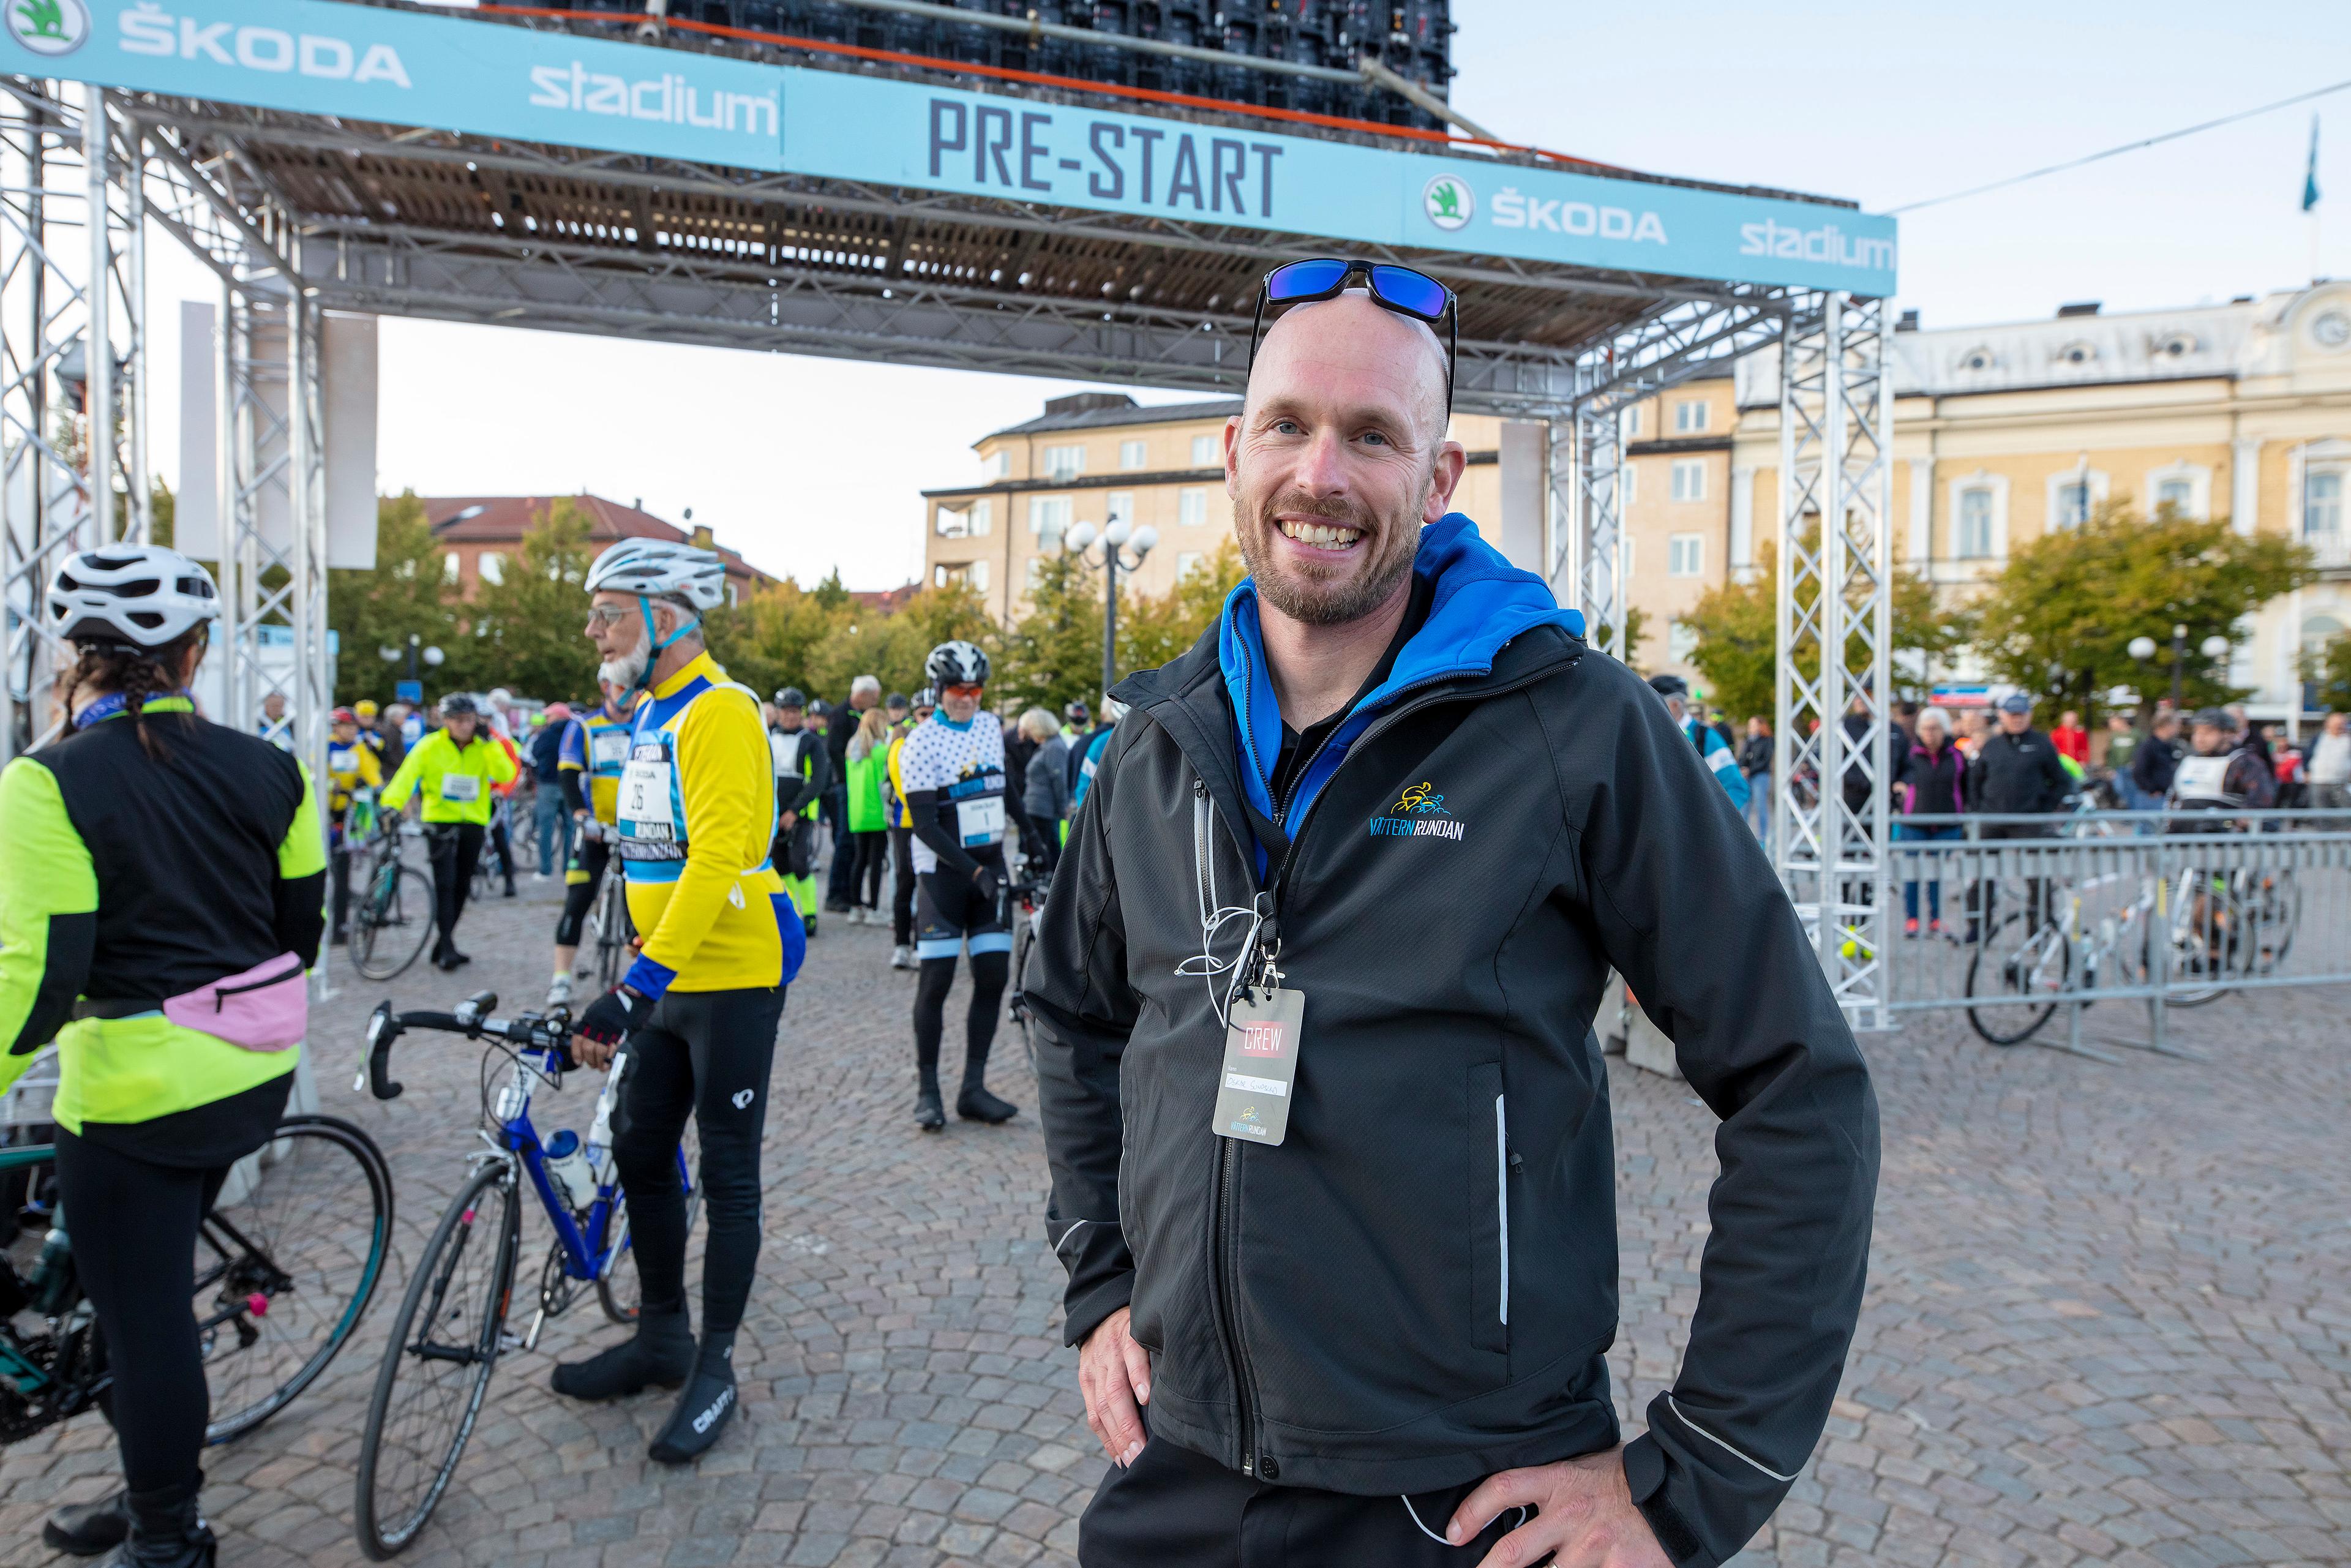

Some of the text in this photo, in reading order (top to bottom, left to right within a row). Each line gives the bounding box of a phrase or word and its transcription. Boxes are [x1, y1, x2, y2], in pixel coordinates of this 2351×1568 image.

[118, 2, 412, 89] ŠKODA
[529, 61, 778, 137] stadium
[929, 98, 1283, 217] PRE-START
[1491, 186, 1668, 245] ŠKODA
[1739, 217, 1896, 271] stadium
[1370, 816, 1465, 841] VÄTTERNRUNDAN
[1244, 1027, 1283, 1051] CREW
[1231, 1121, 1267, 1137] VÄTTERNRUNDAN
